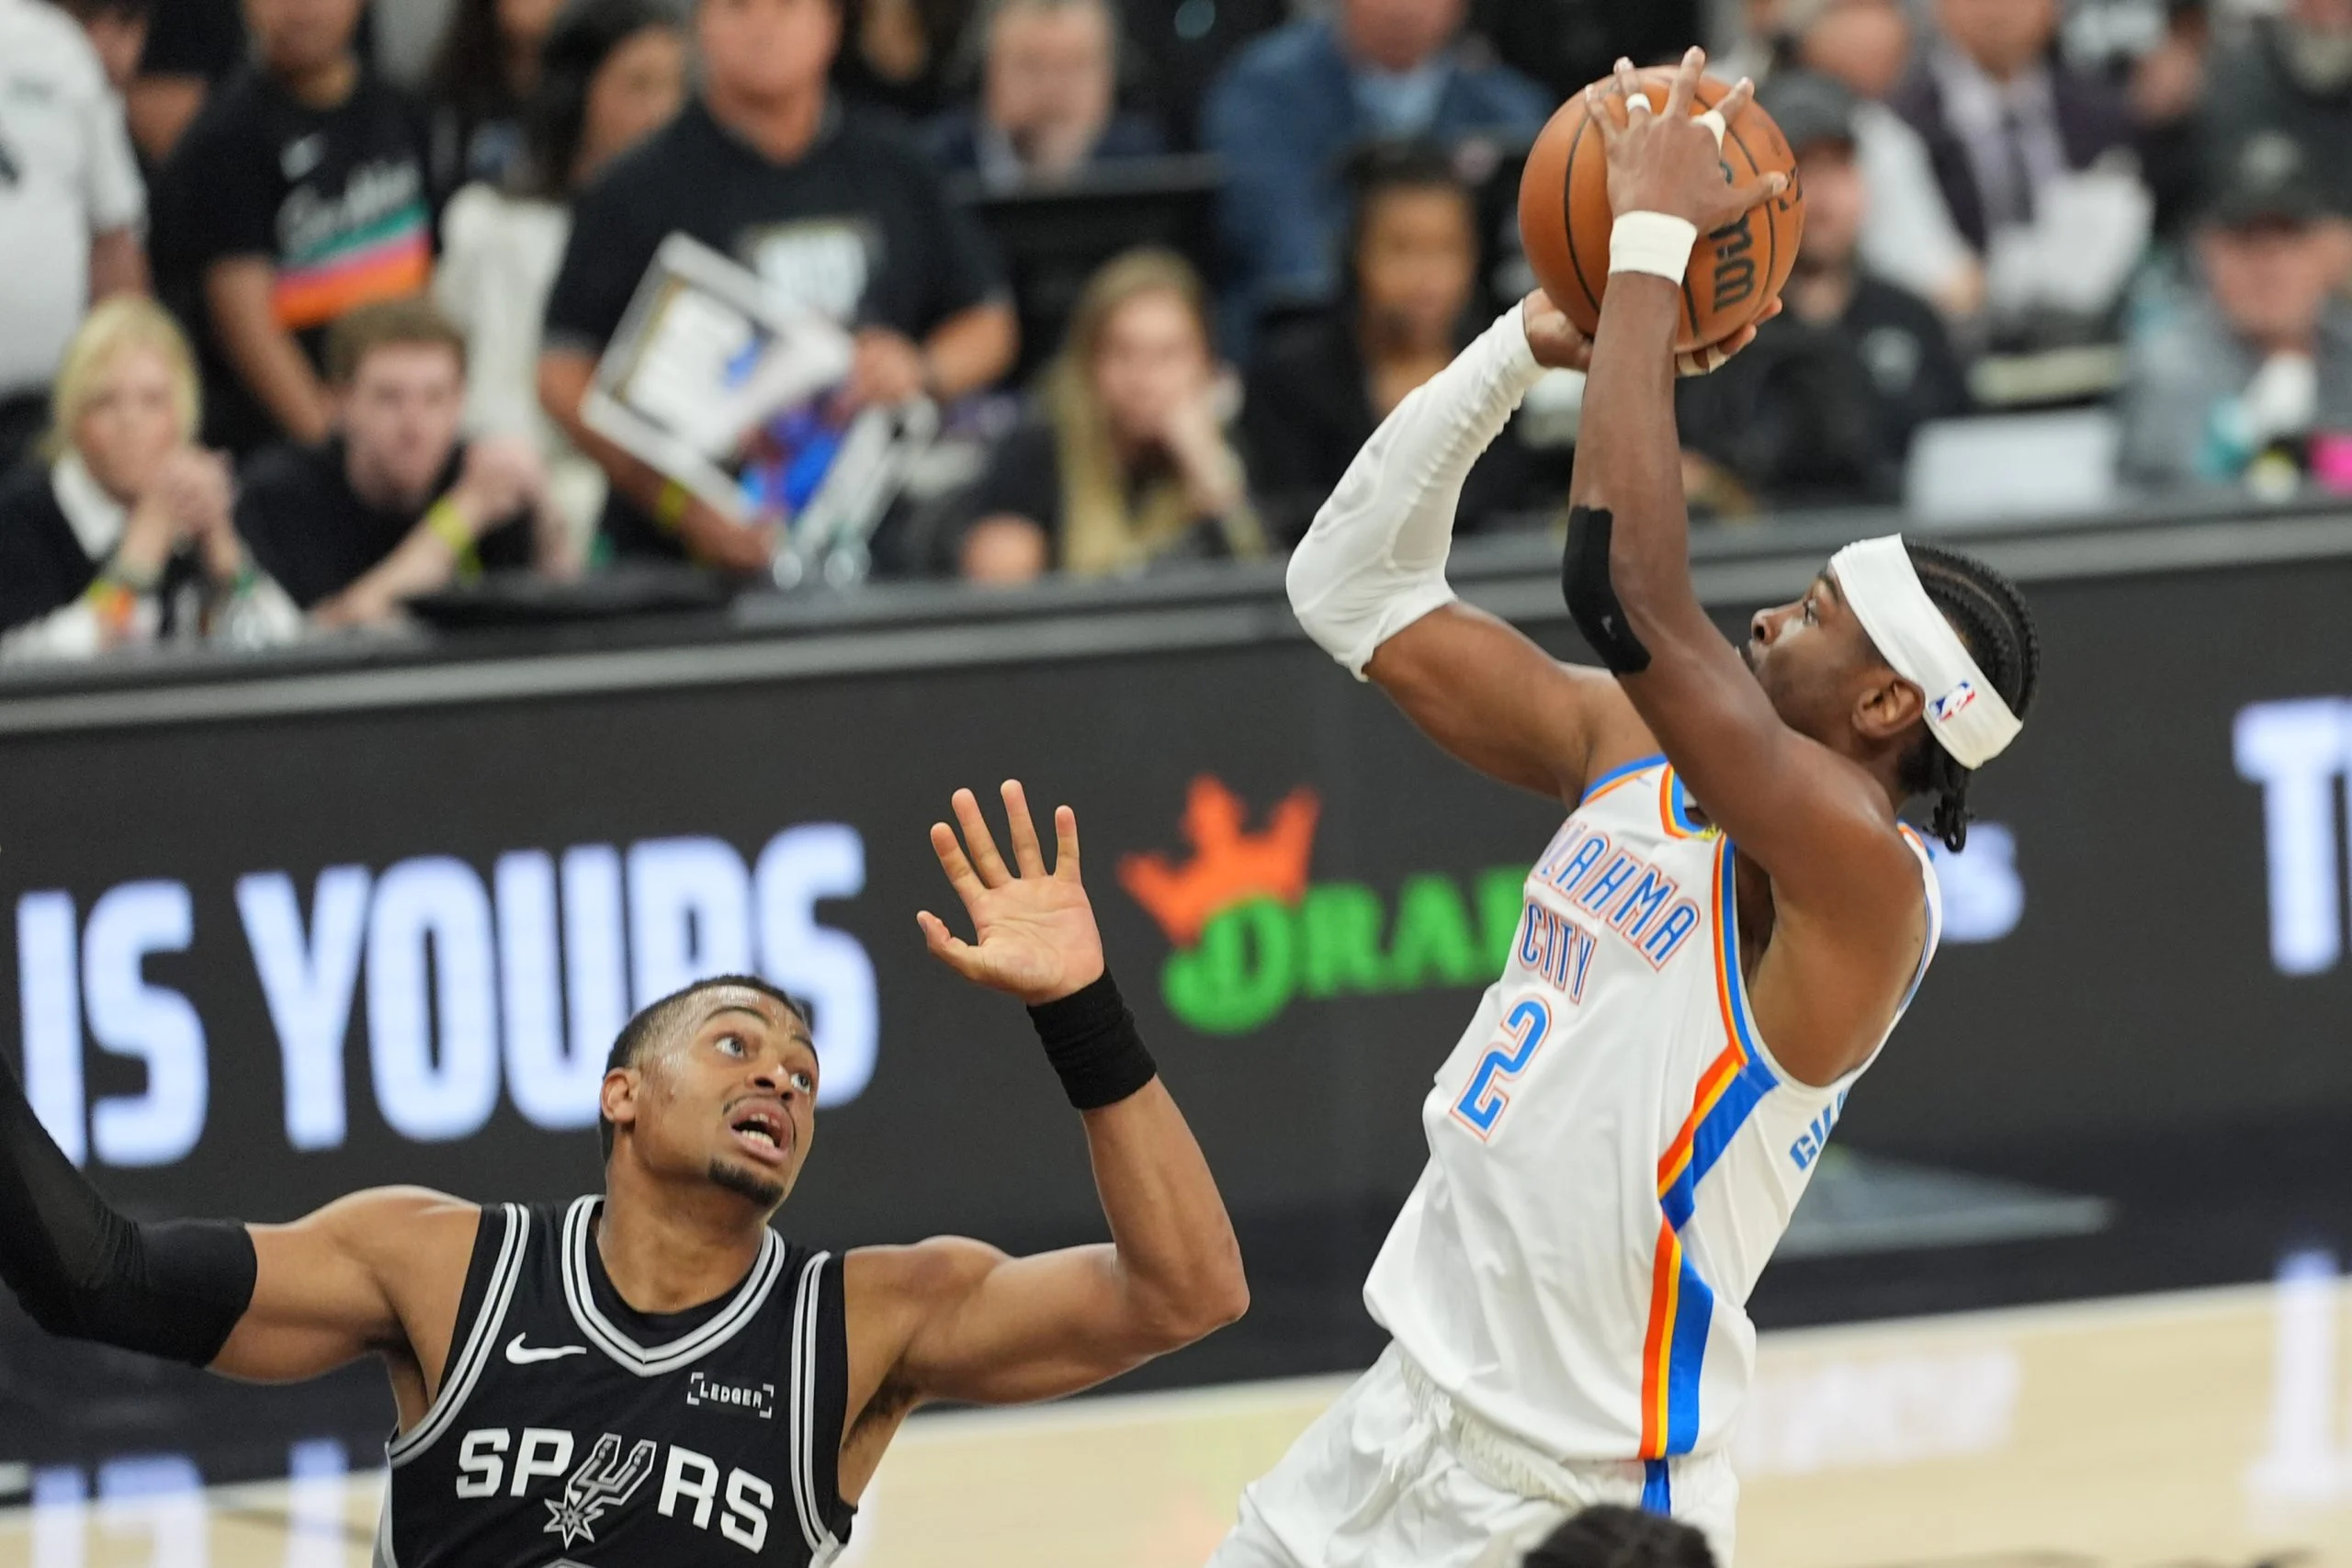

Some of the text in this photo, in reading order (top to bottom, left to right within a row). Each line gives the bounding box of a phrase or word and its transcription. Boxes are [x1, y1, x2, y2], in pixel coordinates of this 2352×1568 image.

[1707, 162, 1758, 315] Wil
[2232, 695, 2352, 976] T
[17, 878, 210, 1168] IS
[1519, 896, 1597, 1005] CITY
[1449, 992, 1553, 1143] 2
[699, 1380, 763, 1409] LEDGER
[456, 1427, 775, 1554] SPURS
